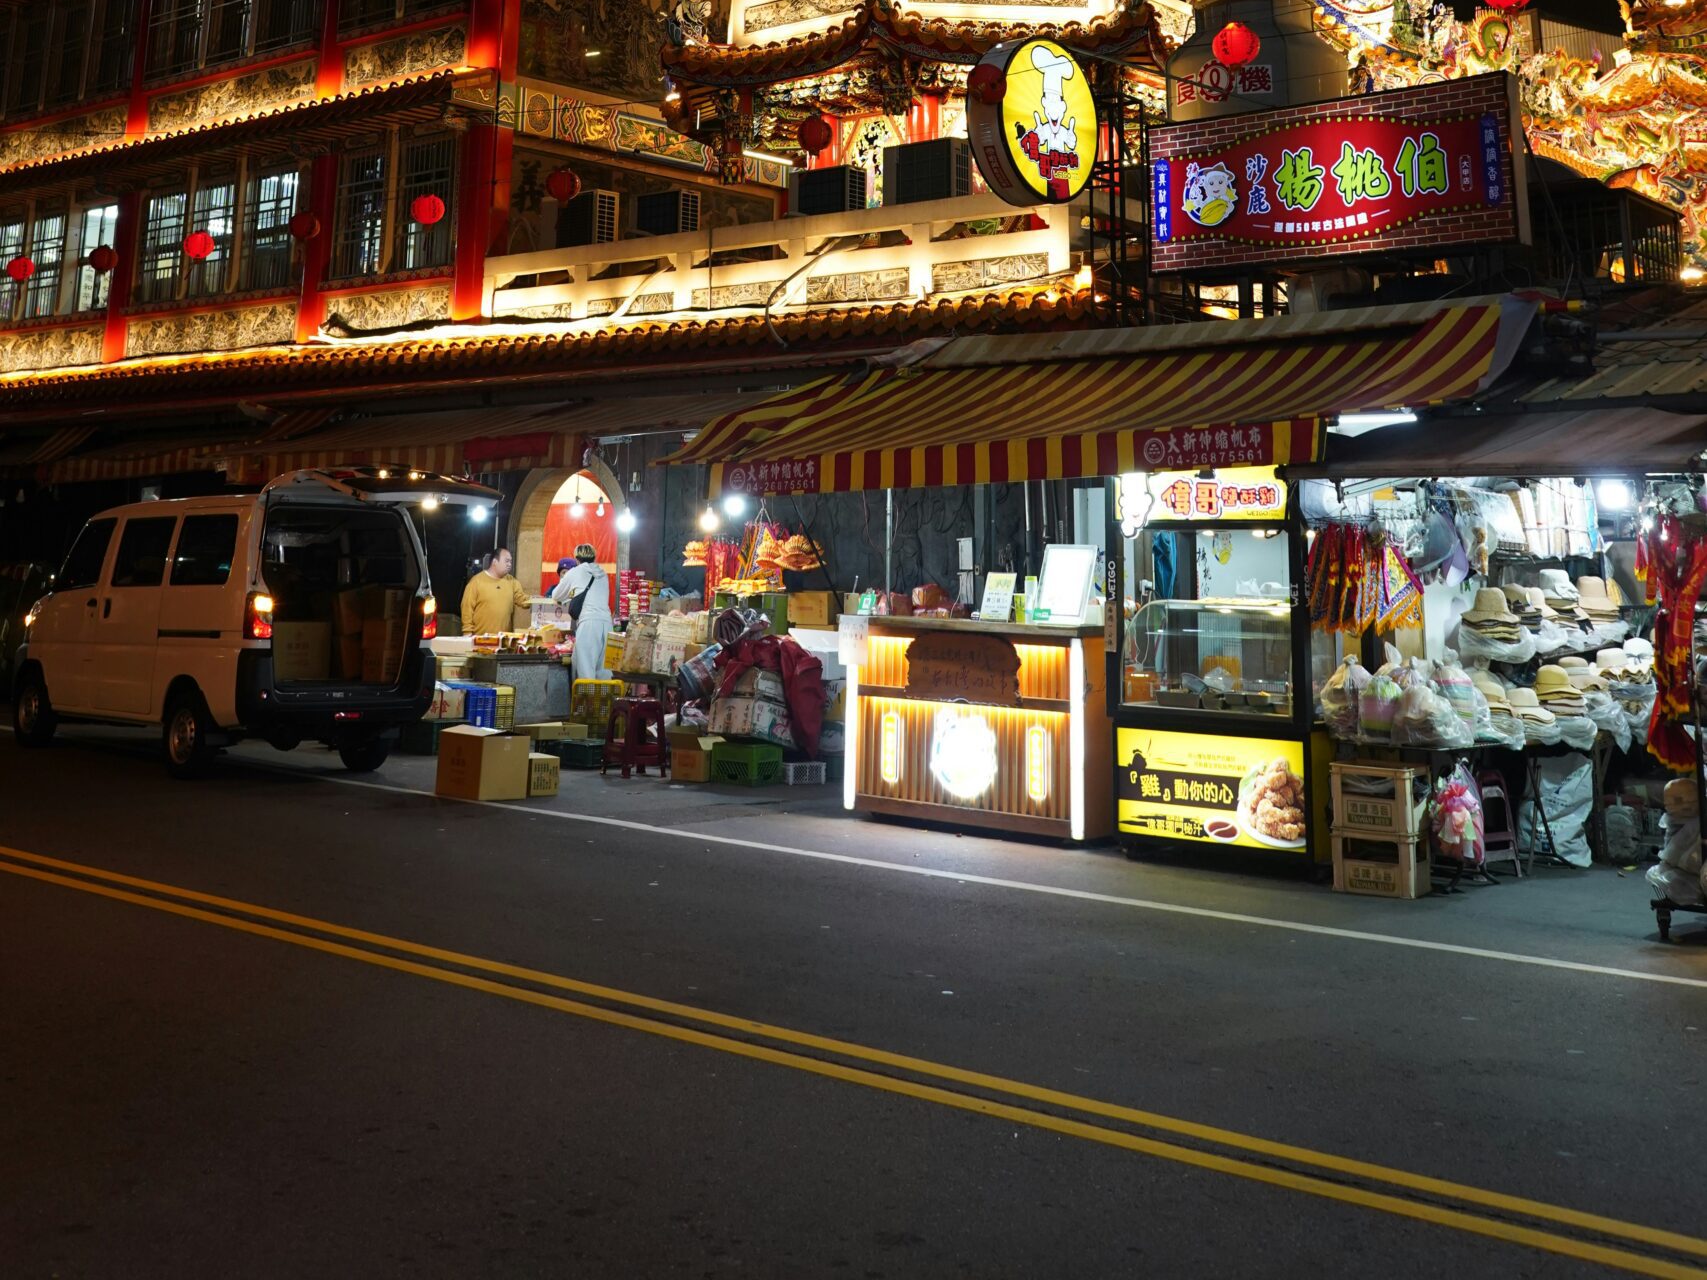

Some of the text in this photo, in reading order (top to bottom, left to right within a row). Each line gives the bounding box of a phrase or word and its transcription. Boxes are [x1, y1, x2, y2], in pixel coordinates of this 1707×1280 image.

[1239, 66, 1272, 94] 機
[1246, 153, 1271, 215] 沙鹿
[1273, 132, 1450, 211] 楊桃伯
[1461, 161, 1471, 185] 大甲店
[1167, 425, 1262, 454] 大新伸縮帆布
[747, 460, 815, 482] 大新伸縮帆布
[1167, 449, 1264, 467] 04-26875561
[1161, 479, 1277, 516] 偉哥鹽酥雞
[1108, 560, 1116, 601] WEIGO
